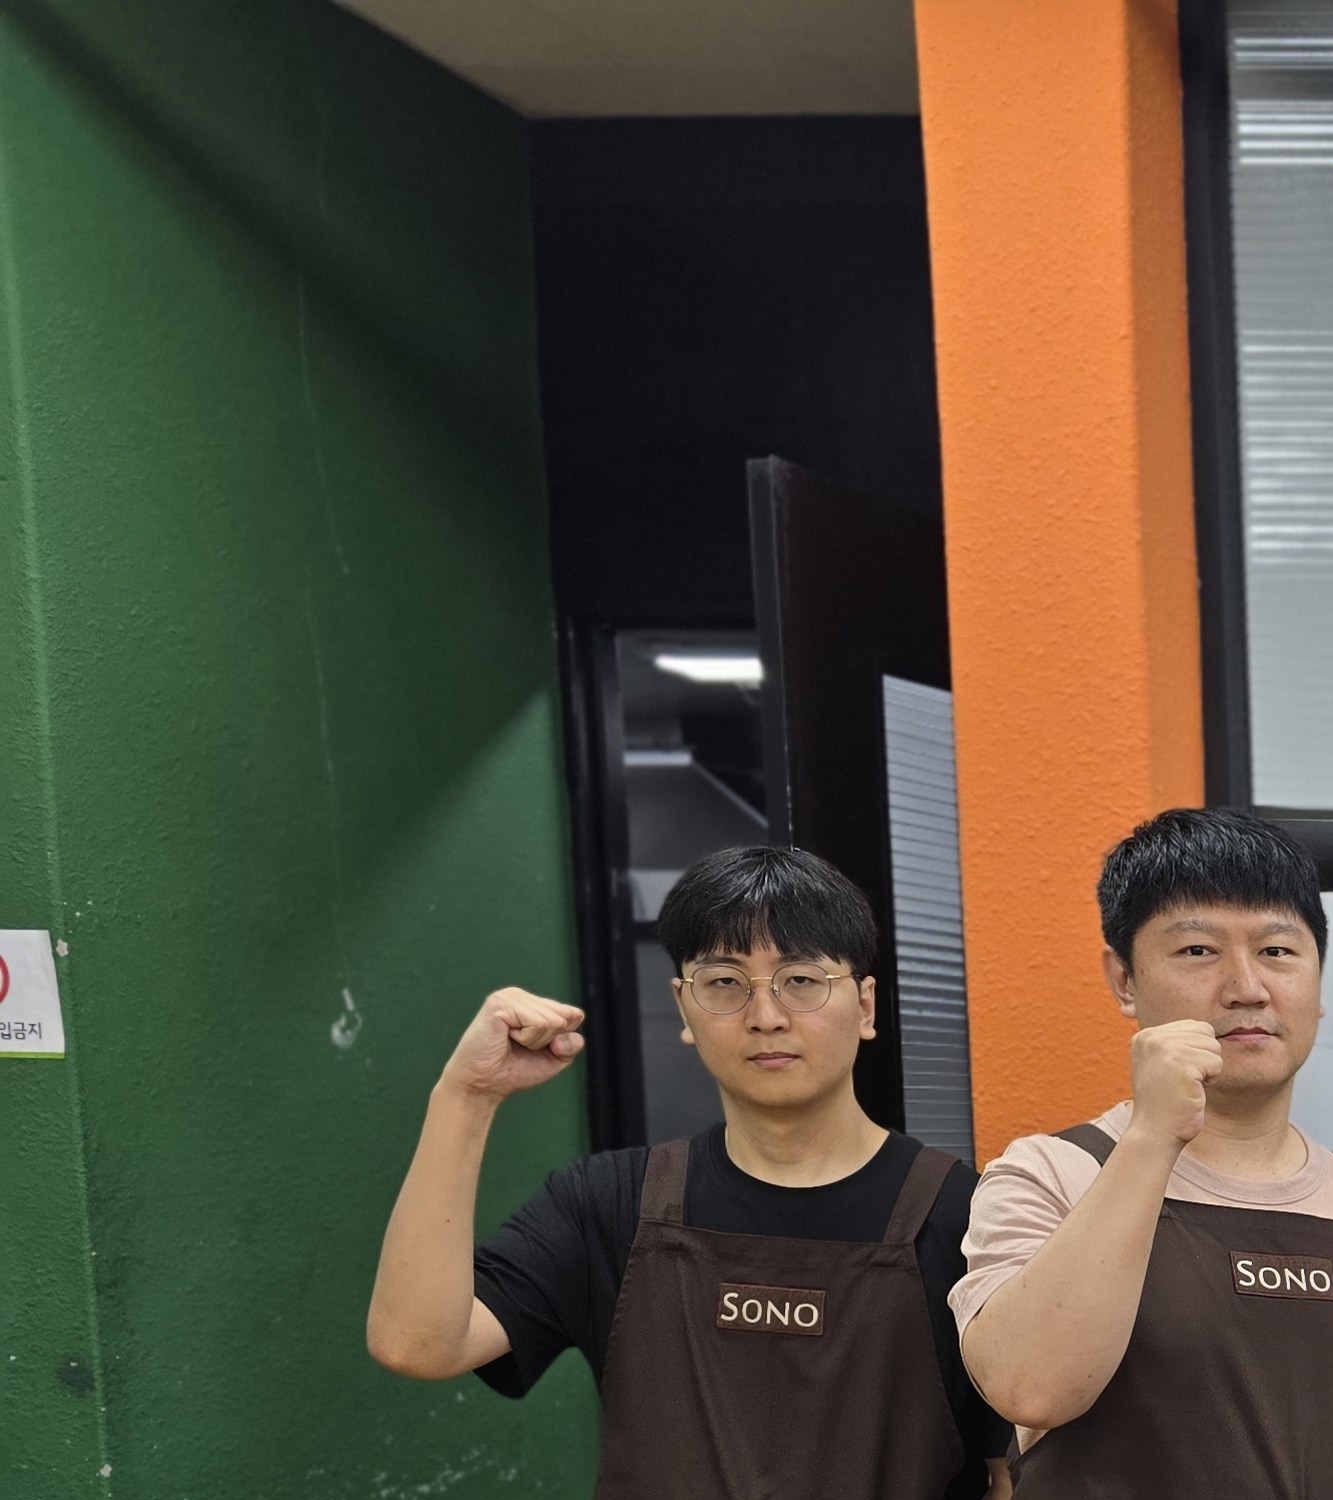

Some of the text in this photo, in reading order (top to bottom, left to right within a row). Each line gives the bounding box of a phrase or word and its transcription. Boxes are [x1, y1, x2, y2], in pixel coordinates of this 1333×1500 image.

[0, 1021, 42, 1040] 입금지
[1236, 1259, 1331, 1293] SONO
[720, 1292, 819, 1328] SONO
